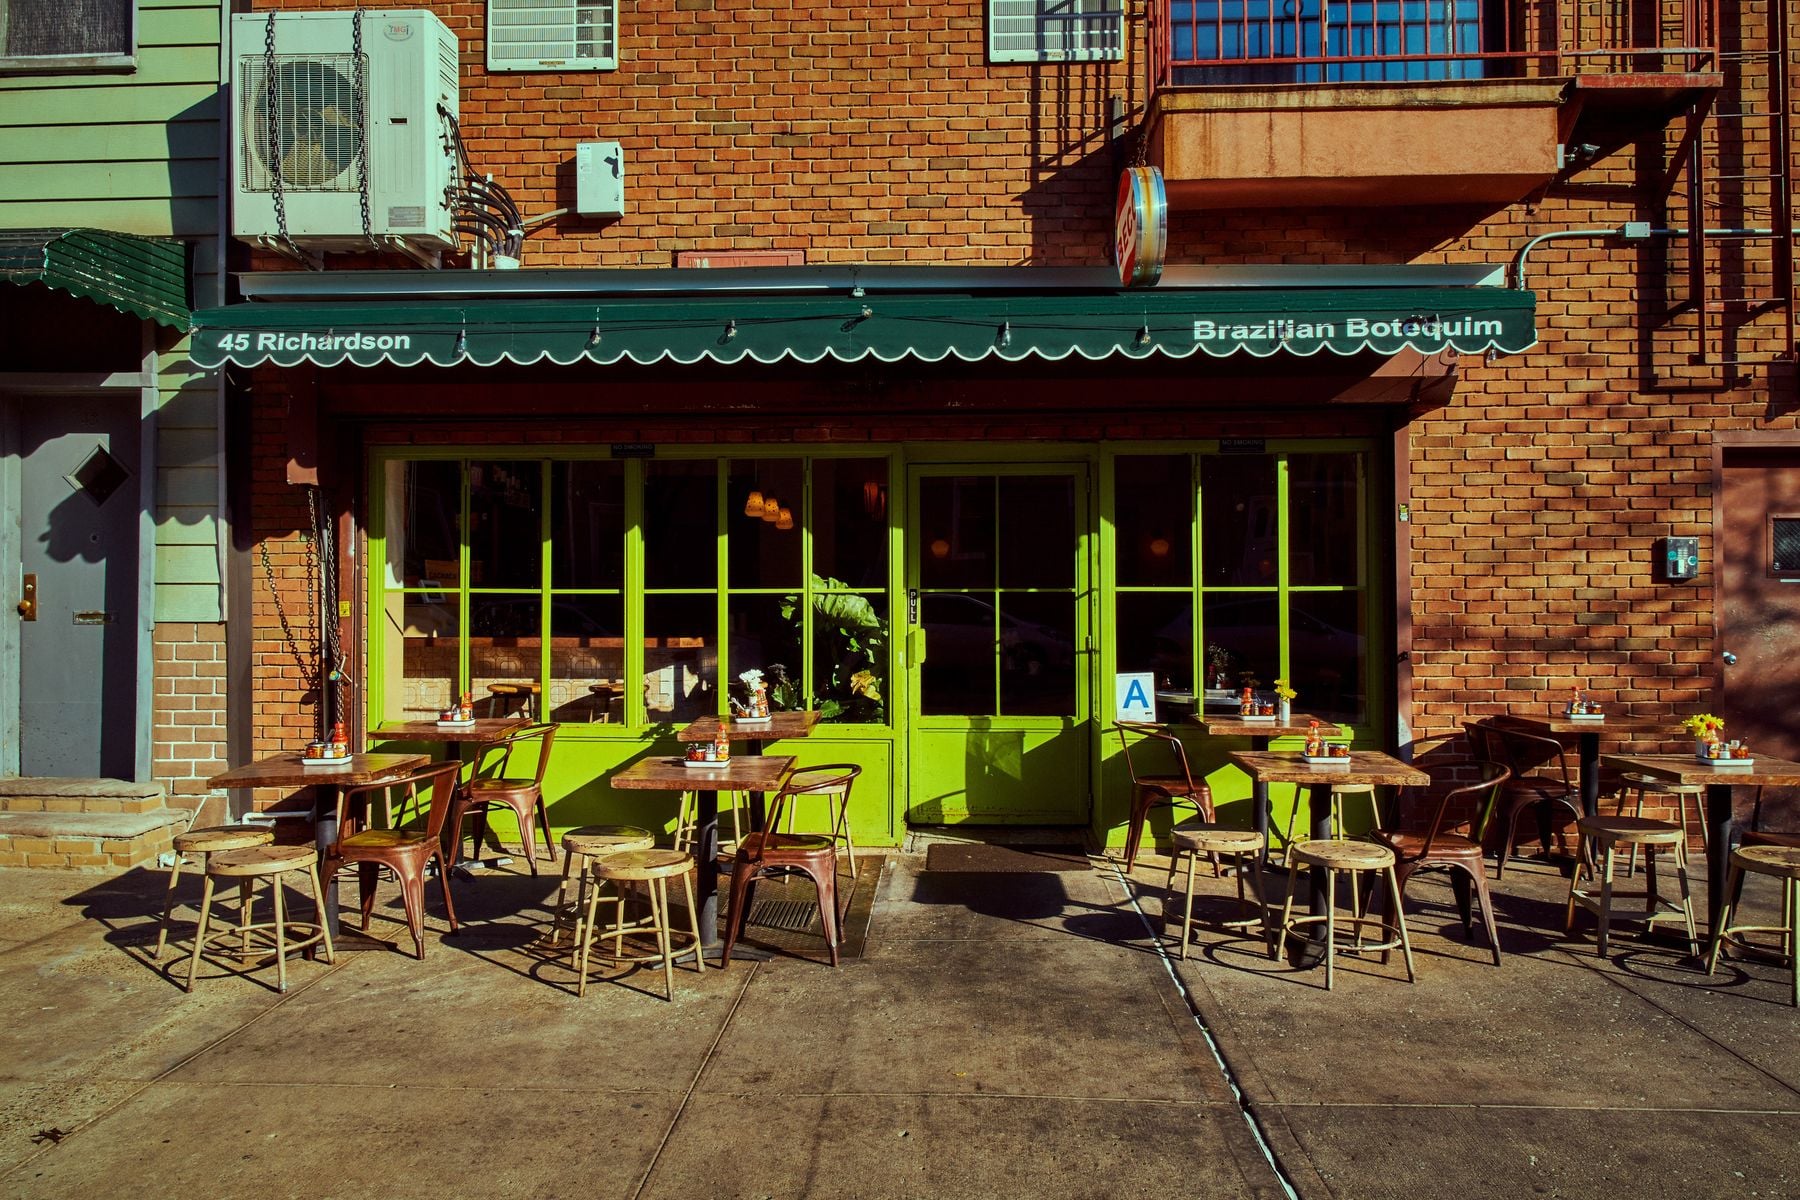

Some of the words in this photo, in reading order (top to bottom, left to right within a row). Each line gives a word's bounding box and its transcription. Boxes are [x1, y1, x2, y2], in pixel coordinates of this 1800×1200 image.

[1194, 319, 1335, 340] Brazilian
[1346, 316, 1503, 341] Botequim
[218, 333, 250, 351] 45
[257, 332, 411, 351] Richardson
[1122, 679, 1150, 709] A
